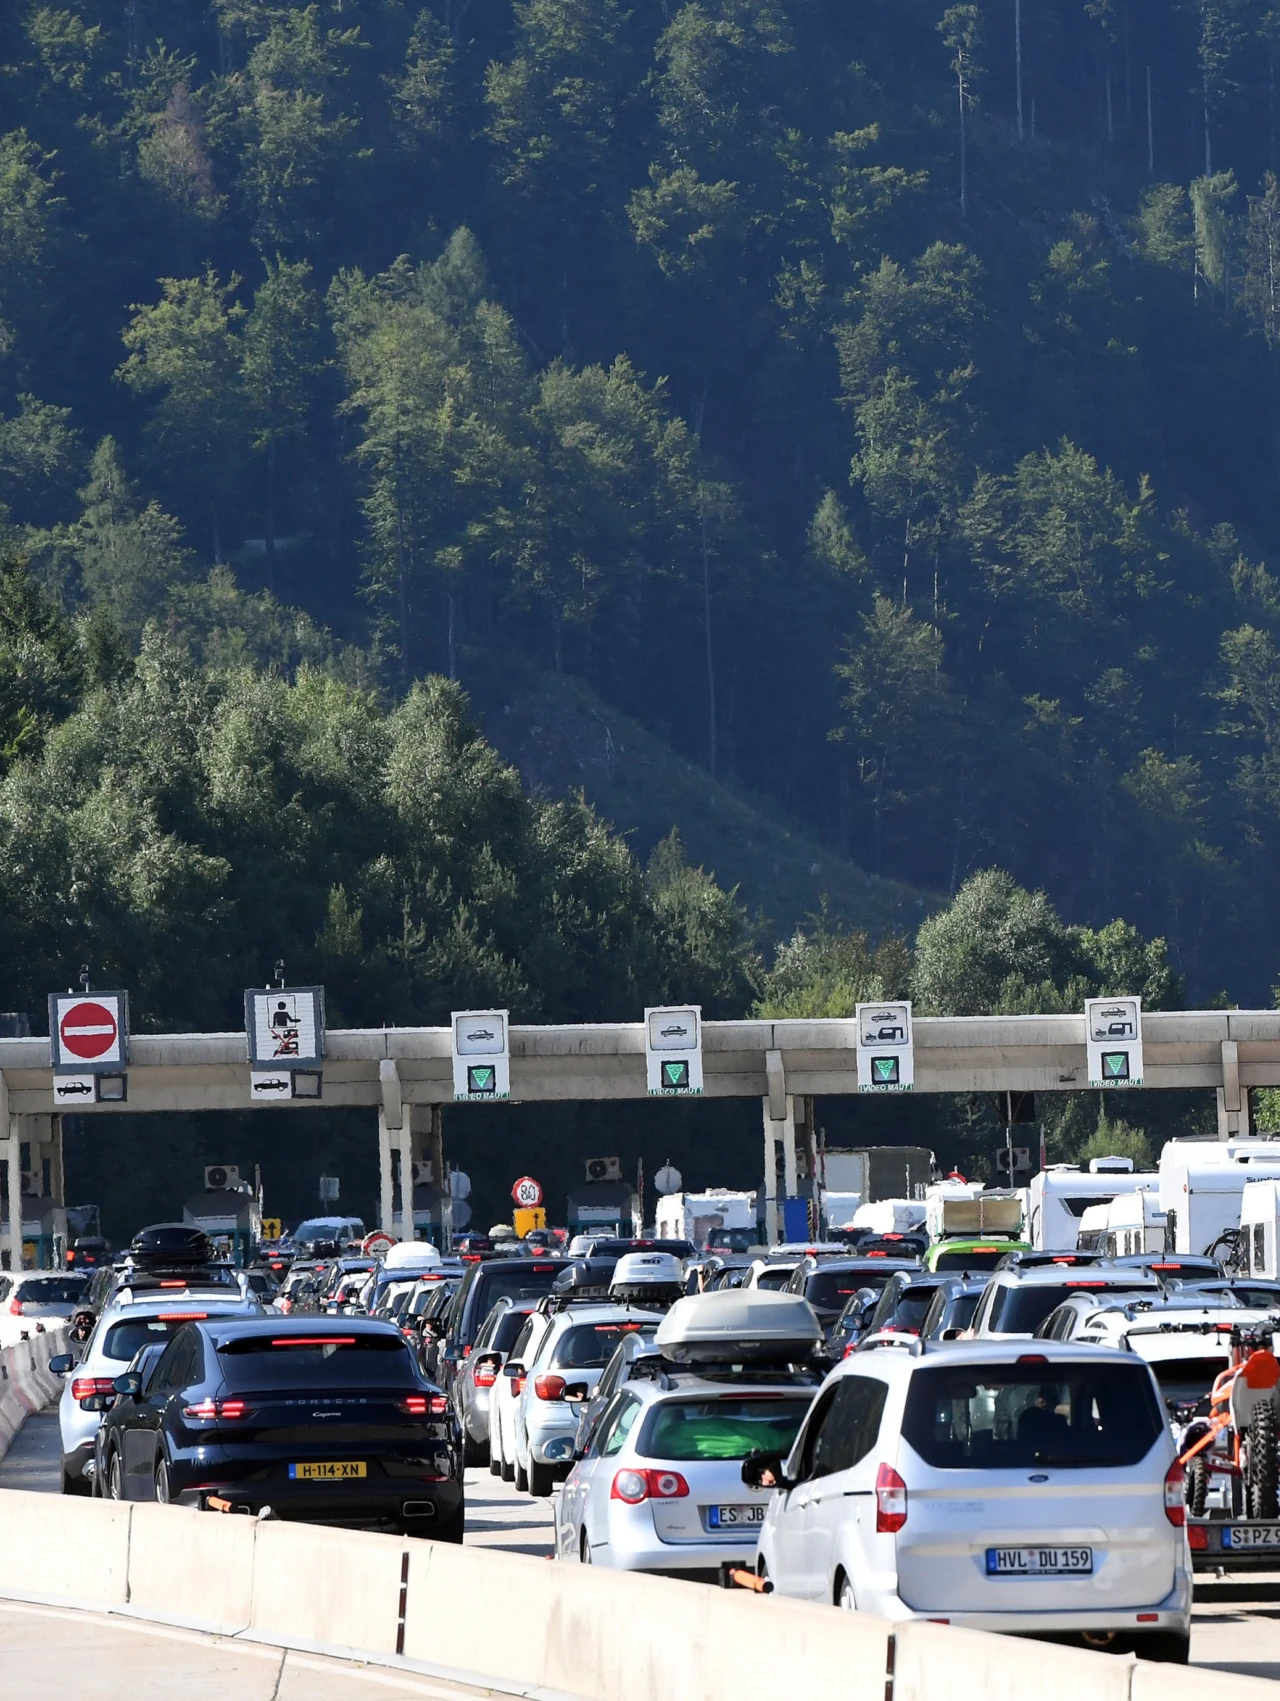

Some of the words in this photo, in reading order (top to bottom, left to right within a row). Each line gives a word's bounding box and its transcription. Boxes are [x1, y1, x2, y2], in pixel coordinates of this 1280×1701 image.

[863, 1084, 886, 1092] VIDEO
[888, 1083, 909, 1091] MAUT
[1117, 1078, 1138, 1086] MAUT
[520, 1184, 536, 1201] 80
[303, 1464, 359, 1477] H-114-XN
[720, 1507, 737, 1523] ES
[747, 1506, 765, 1522] JB
[1232, 1529, 1242, 1544] S
[1252, 1528, 1272, 1543] PZ
[997, 1550, 1027, 1568] HVL
[1039, 1550, 1058, 1567] DU
[1061, 1550, 1089, 1567] 159
